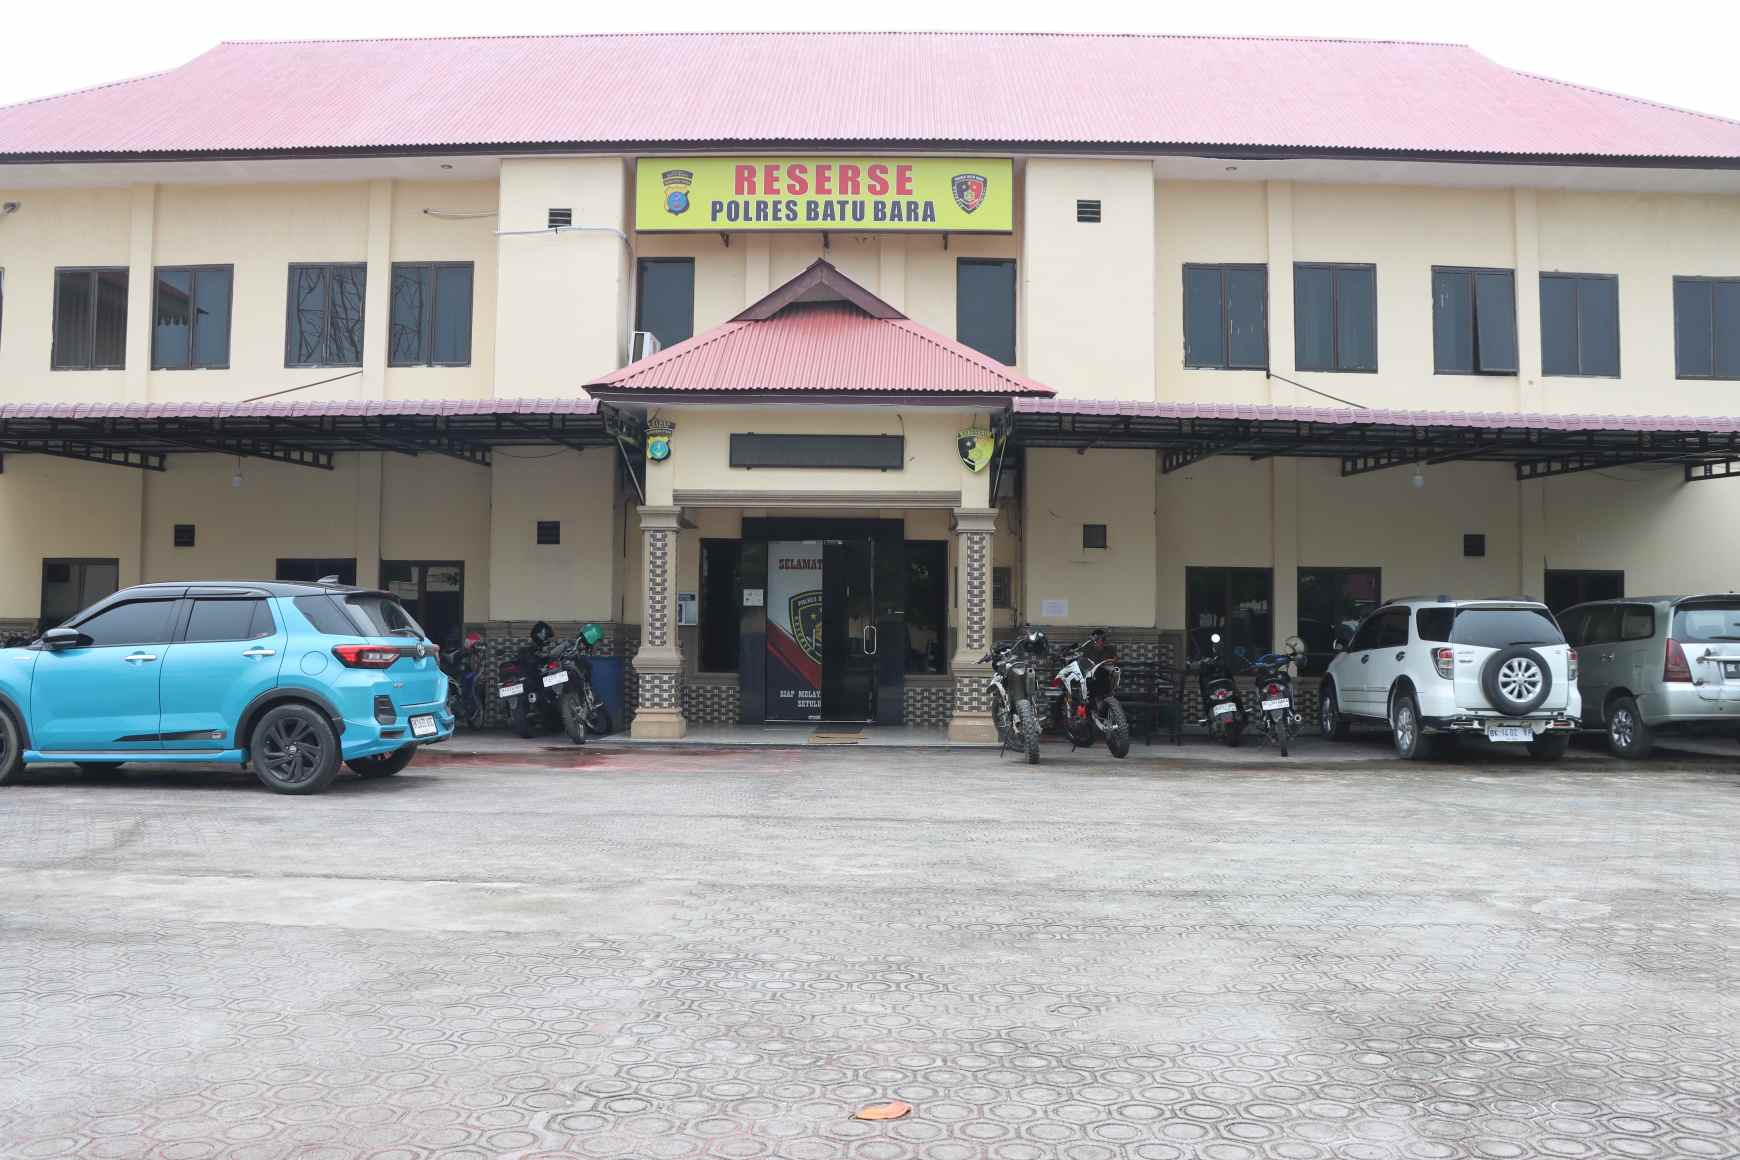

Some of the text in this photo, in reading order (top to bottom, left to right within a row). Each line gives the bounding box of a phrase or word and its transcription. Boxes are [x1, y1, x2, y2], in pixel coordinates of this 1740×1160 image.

[735, 164, 913, 196] RESERSE
[711, 199, 936, 222] POLRES BATU BARA
[778, 558, 823, 570] SELAMAT
